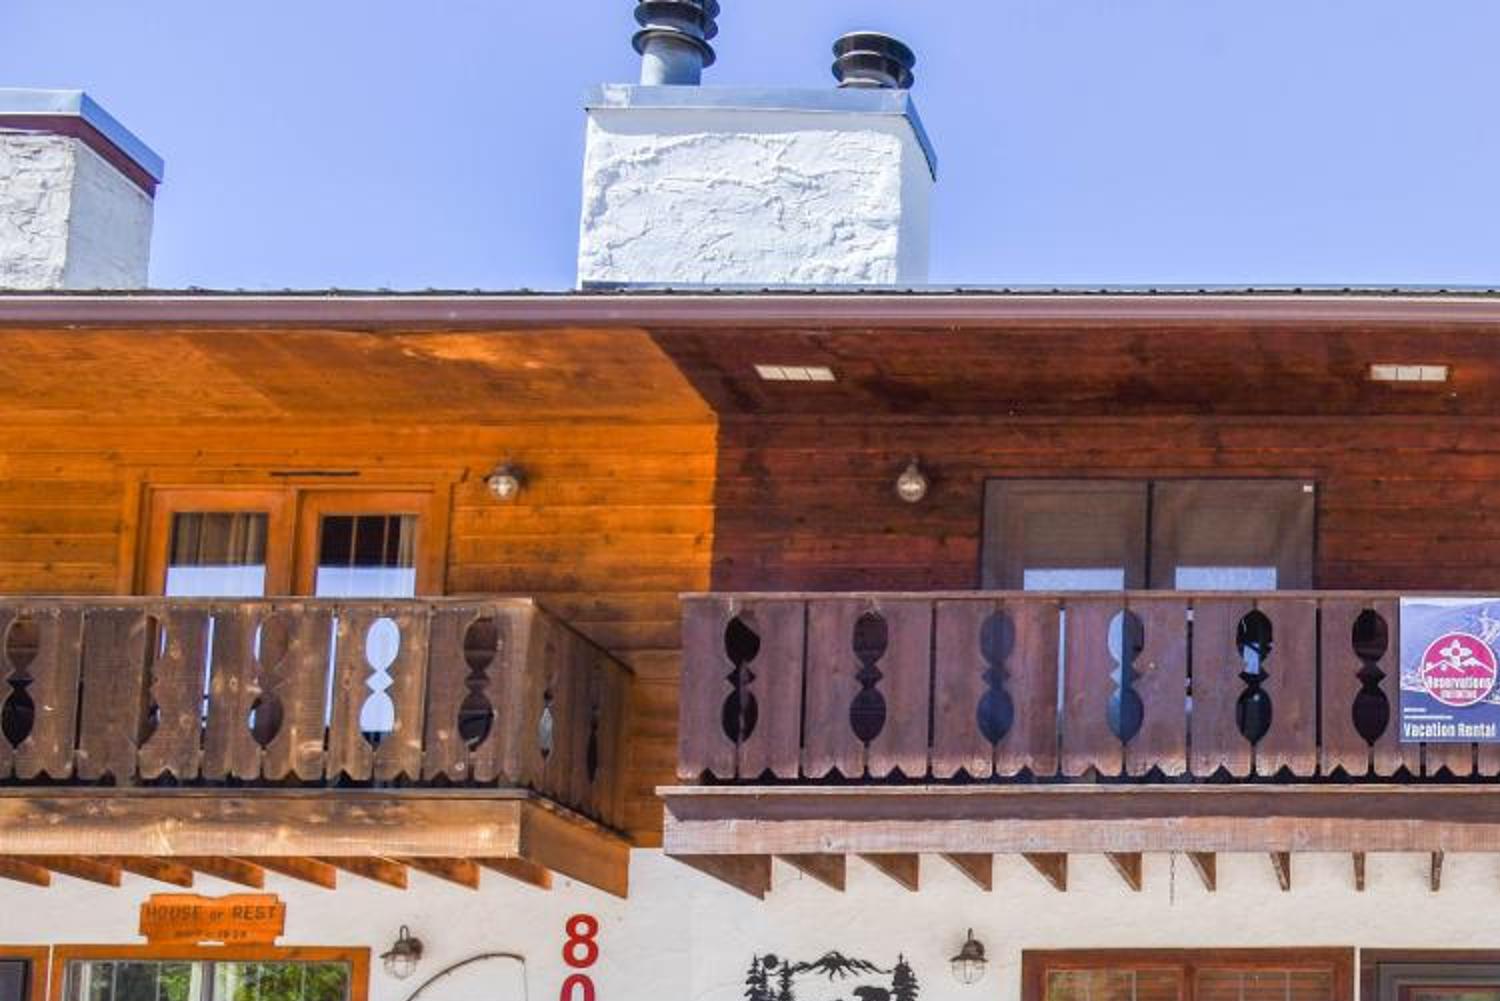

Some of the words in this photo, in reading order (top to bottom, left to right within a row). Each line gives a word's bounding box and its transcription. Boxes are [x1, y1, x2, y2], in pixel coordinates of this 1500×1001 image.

[1403, 721, 1455, 737] Vacation
[1458, 722, 1496, 737] Rental
[147, 904, 199, 921] HOUSE
[232, 905, 276, 921] REST
